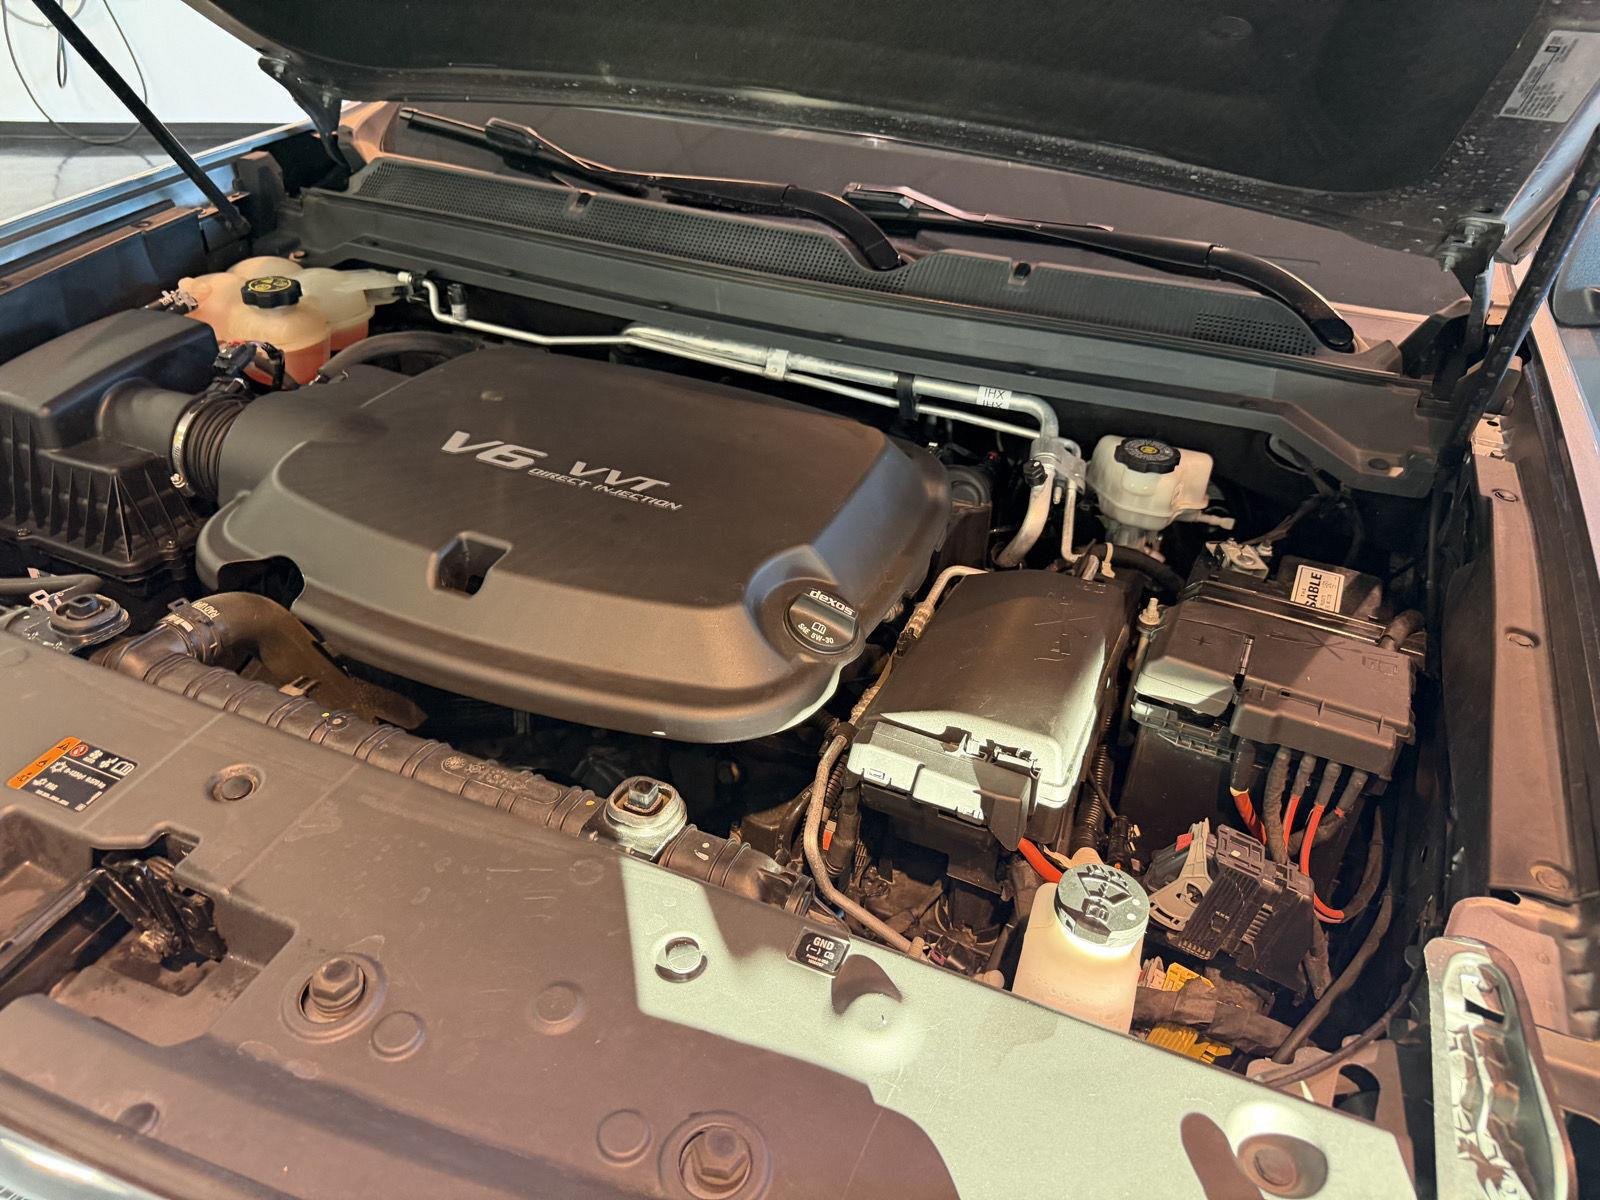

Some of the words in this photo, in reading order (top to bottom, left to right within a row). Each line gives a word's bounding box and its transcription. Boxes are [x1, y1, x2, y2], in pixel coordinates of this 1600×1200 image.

[441, 430, 549, 469] V6
[527, 468, 592, 488] DIRECT
[592, 484, 684, 511] INJECTION
[569, 461, 671, 491] VVT
[809, 590, 855, 616] dexos
[1304, 572, 1322, 608] SABLE
[797, 622, 810, 635] SAE
[813, 937, 834, 950] GND
